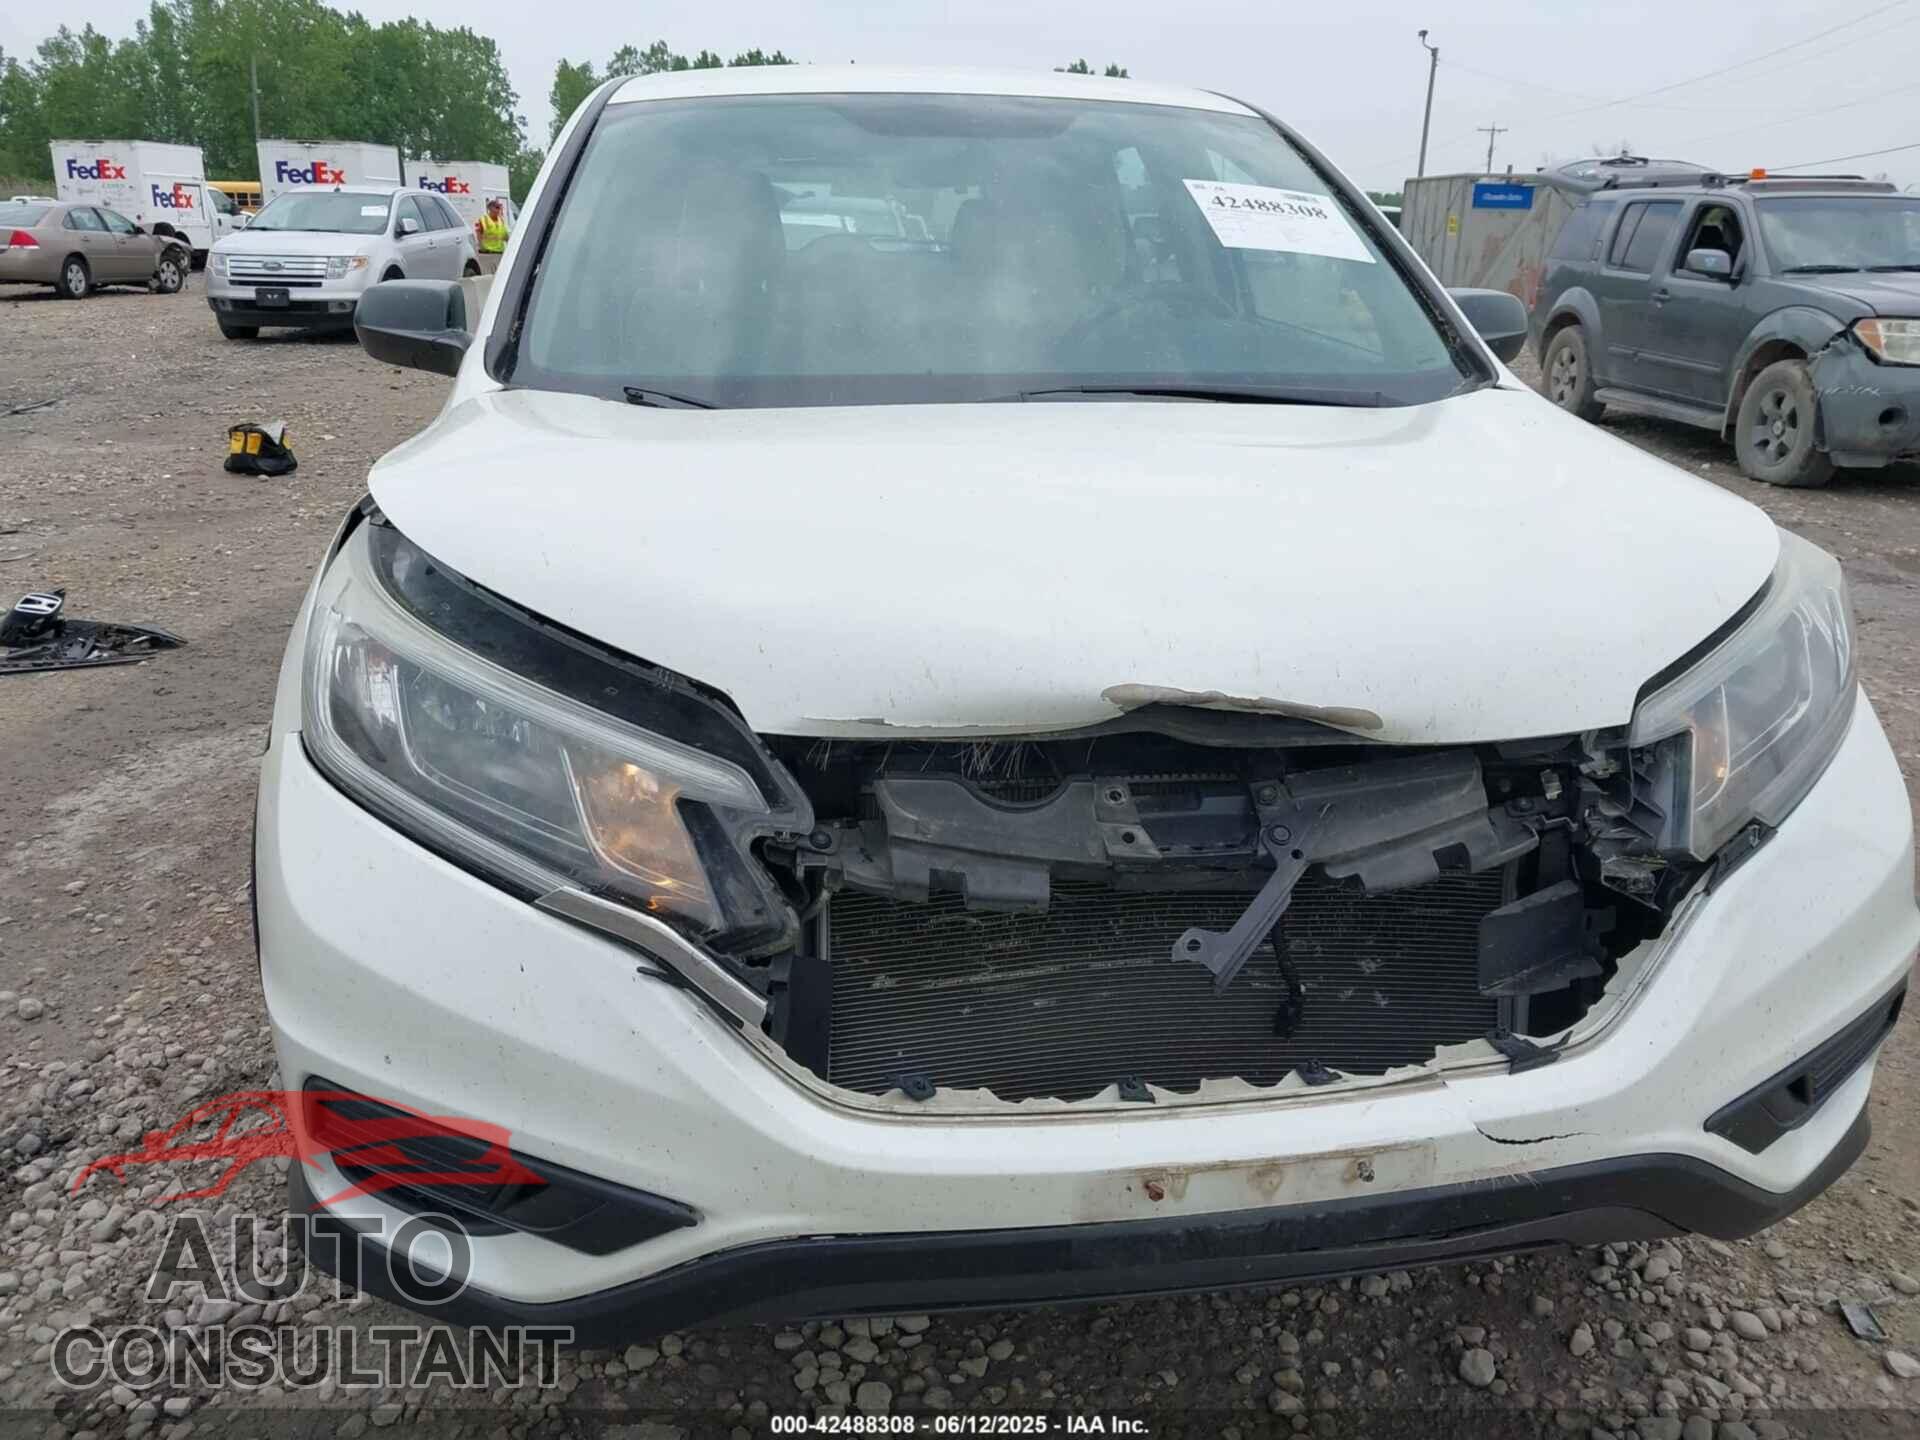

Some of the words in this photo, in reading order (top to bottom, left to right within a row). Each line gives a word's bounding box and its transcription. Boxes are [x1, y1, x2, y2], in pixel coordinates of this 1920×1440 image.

[66, 159, 127, 180] FedEx
[275, 160, 346, 184] FedEx
[151, 182, 193, 209] FedEx
[419, 176, 470, 194] FedEx
[1211, 195, 1328, 220] 42488308
